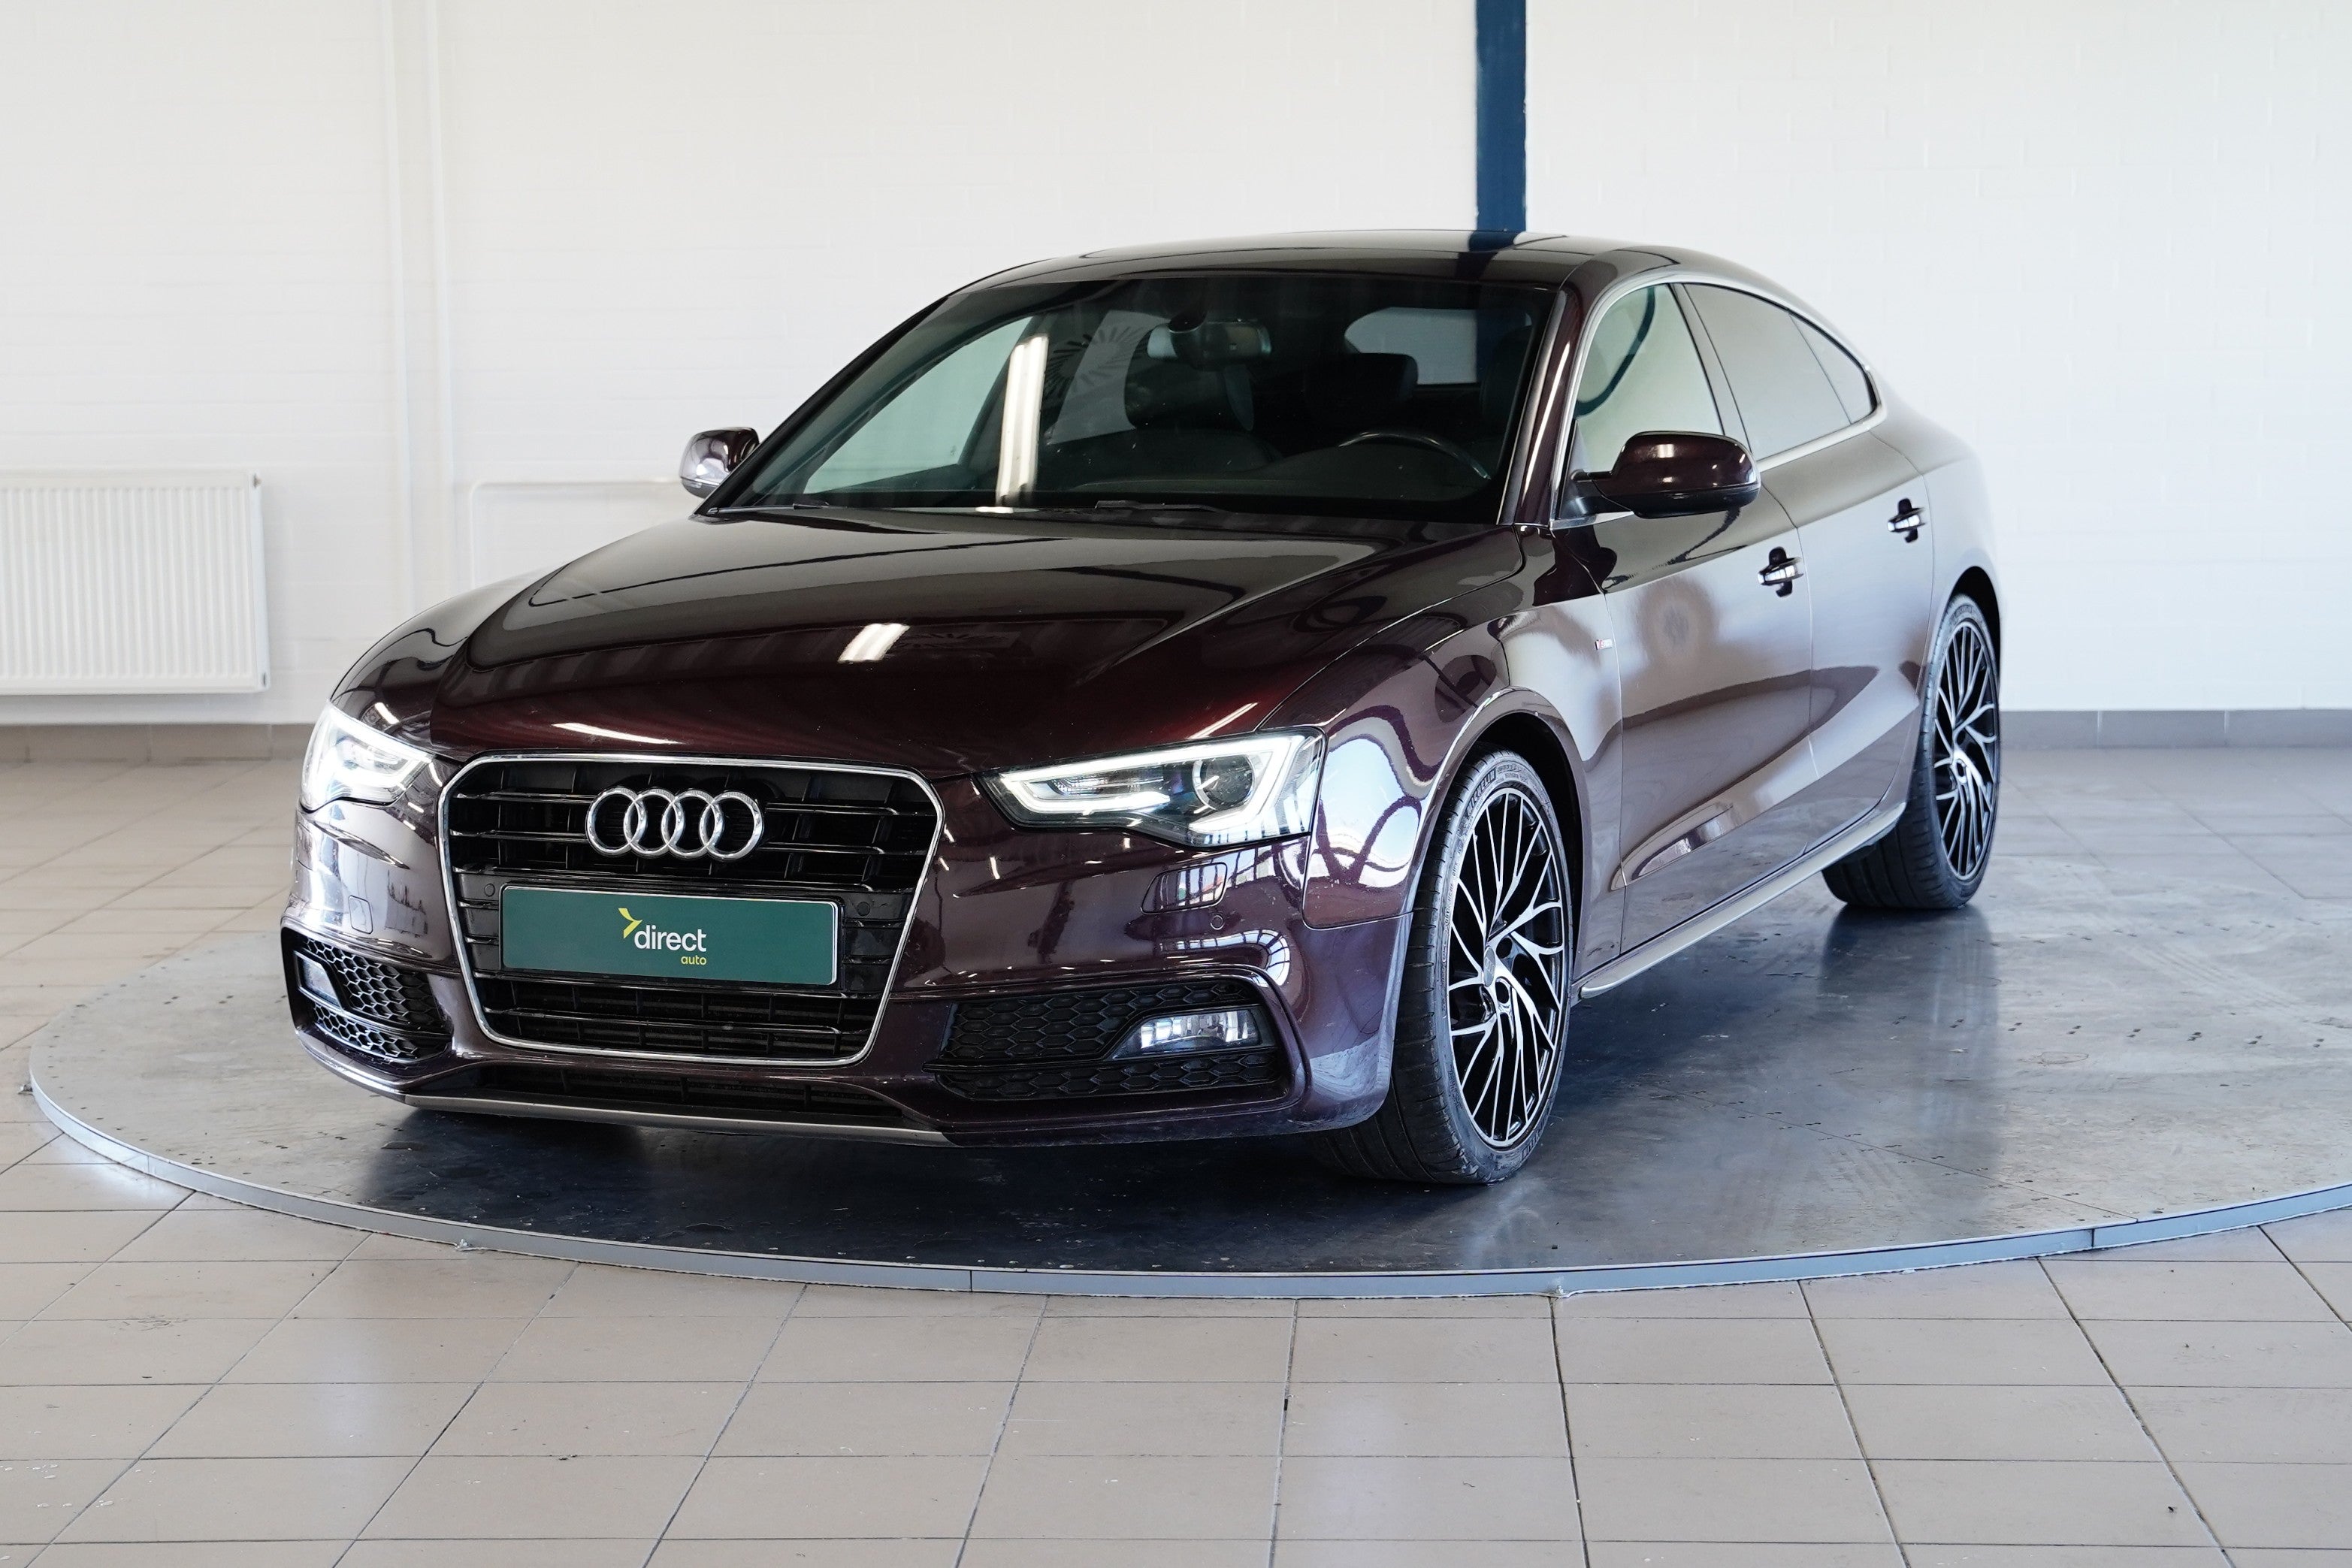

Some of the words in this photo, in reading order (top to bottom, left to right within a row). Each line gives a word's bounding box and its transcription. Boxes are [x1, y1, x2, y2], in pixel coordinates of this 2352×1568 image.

[1466, 767, 1496, 818] MICHELIN
[634, 925, 706, 952] direct
[681, 955, 707, 965] auto
